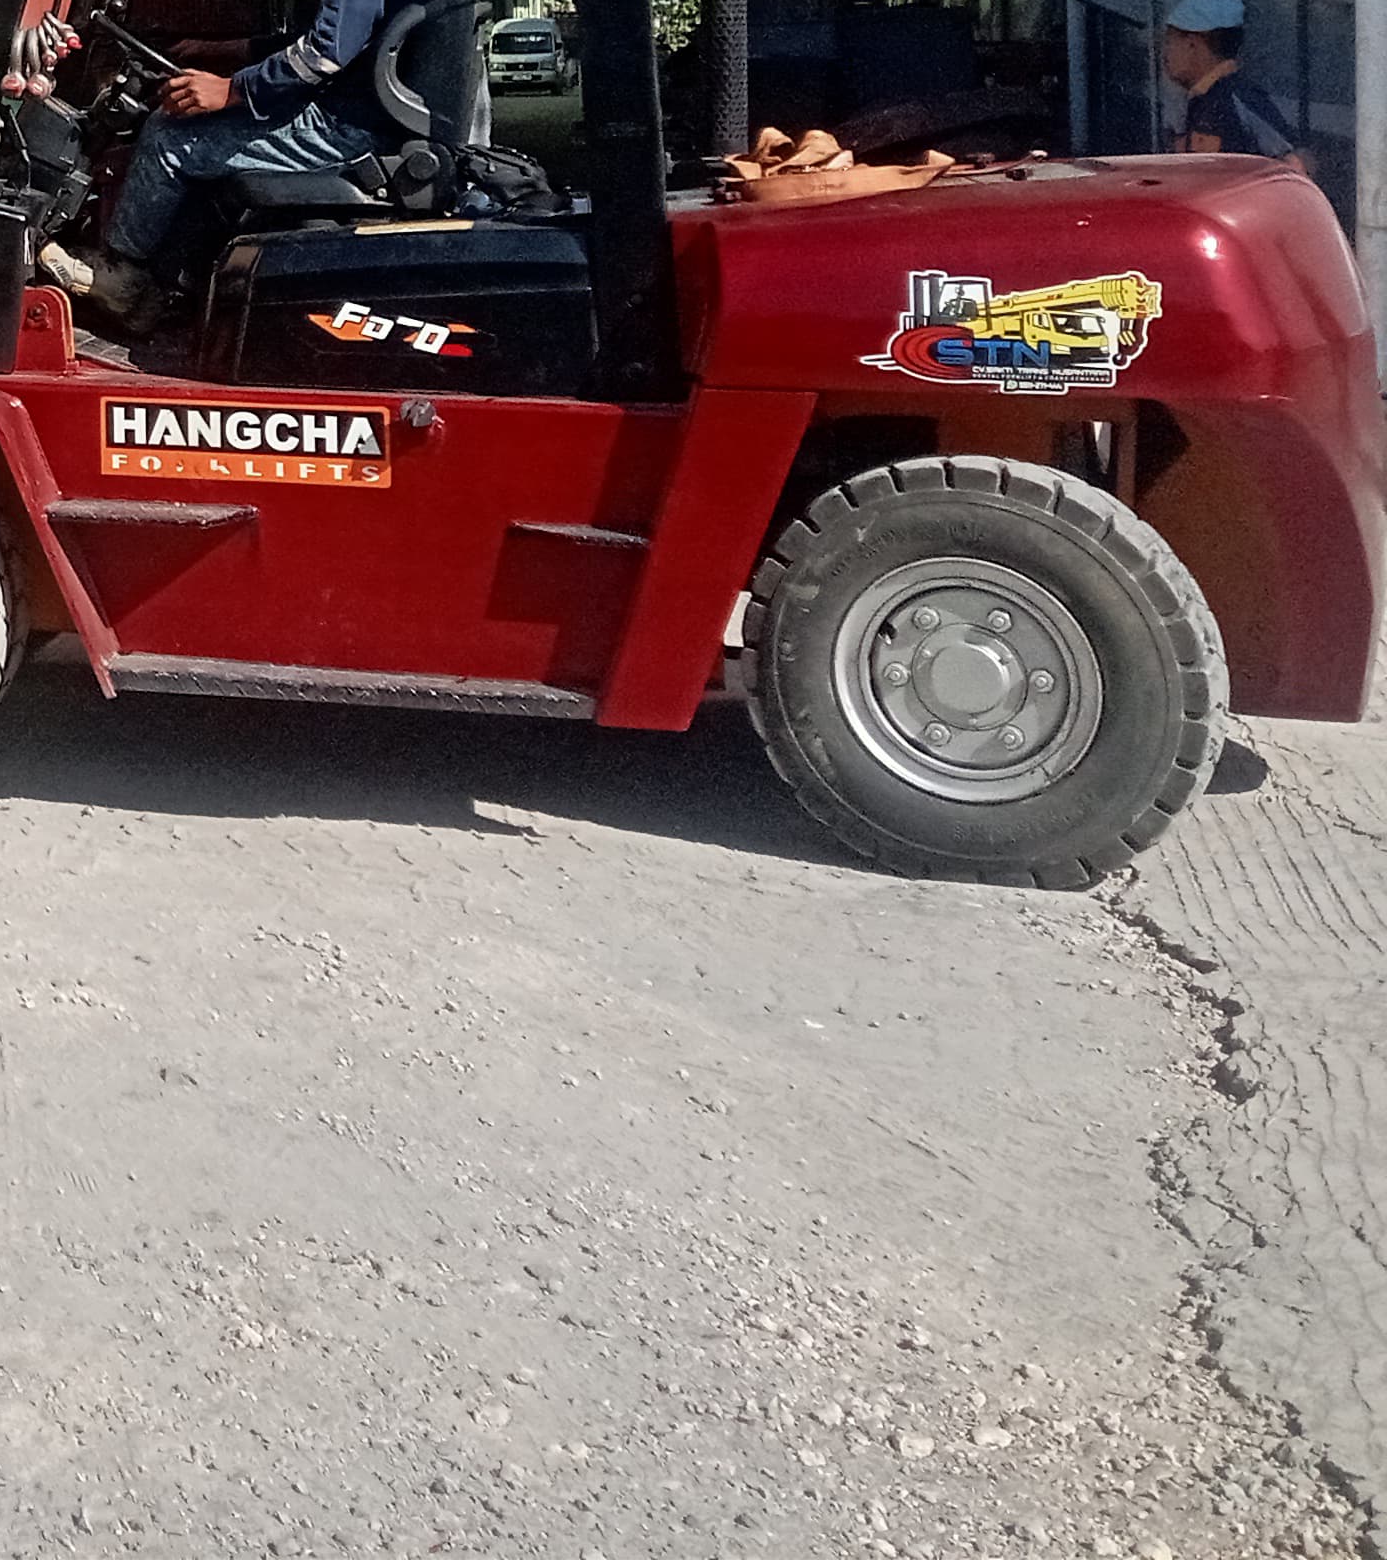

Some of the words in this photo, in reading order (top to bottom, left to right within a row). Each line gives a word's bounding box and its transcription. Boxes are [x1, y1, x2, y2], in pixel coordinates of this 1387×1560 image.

[937, 338, 1051, 368] STN
[111, 405, 383, 456] HANGCHA
[110, 453, 381, 483] FOKLIFTS
